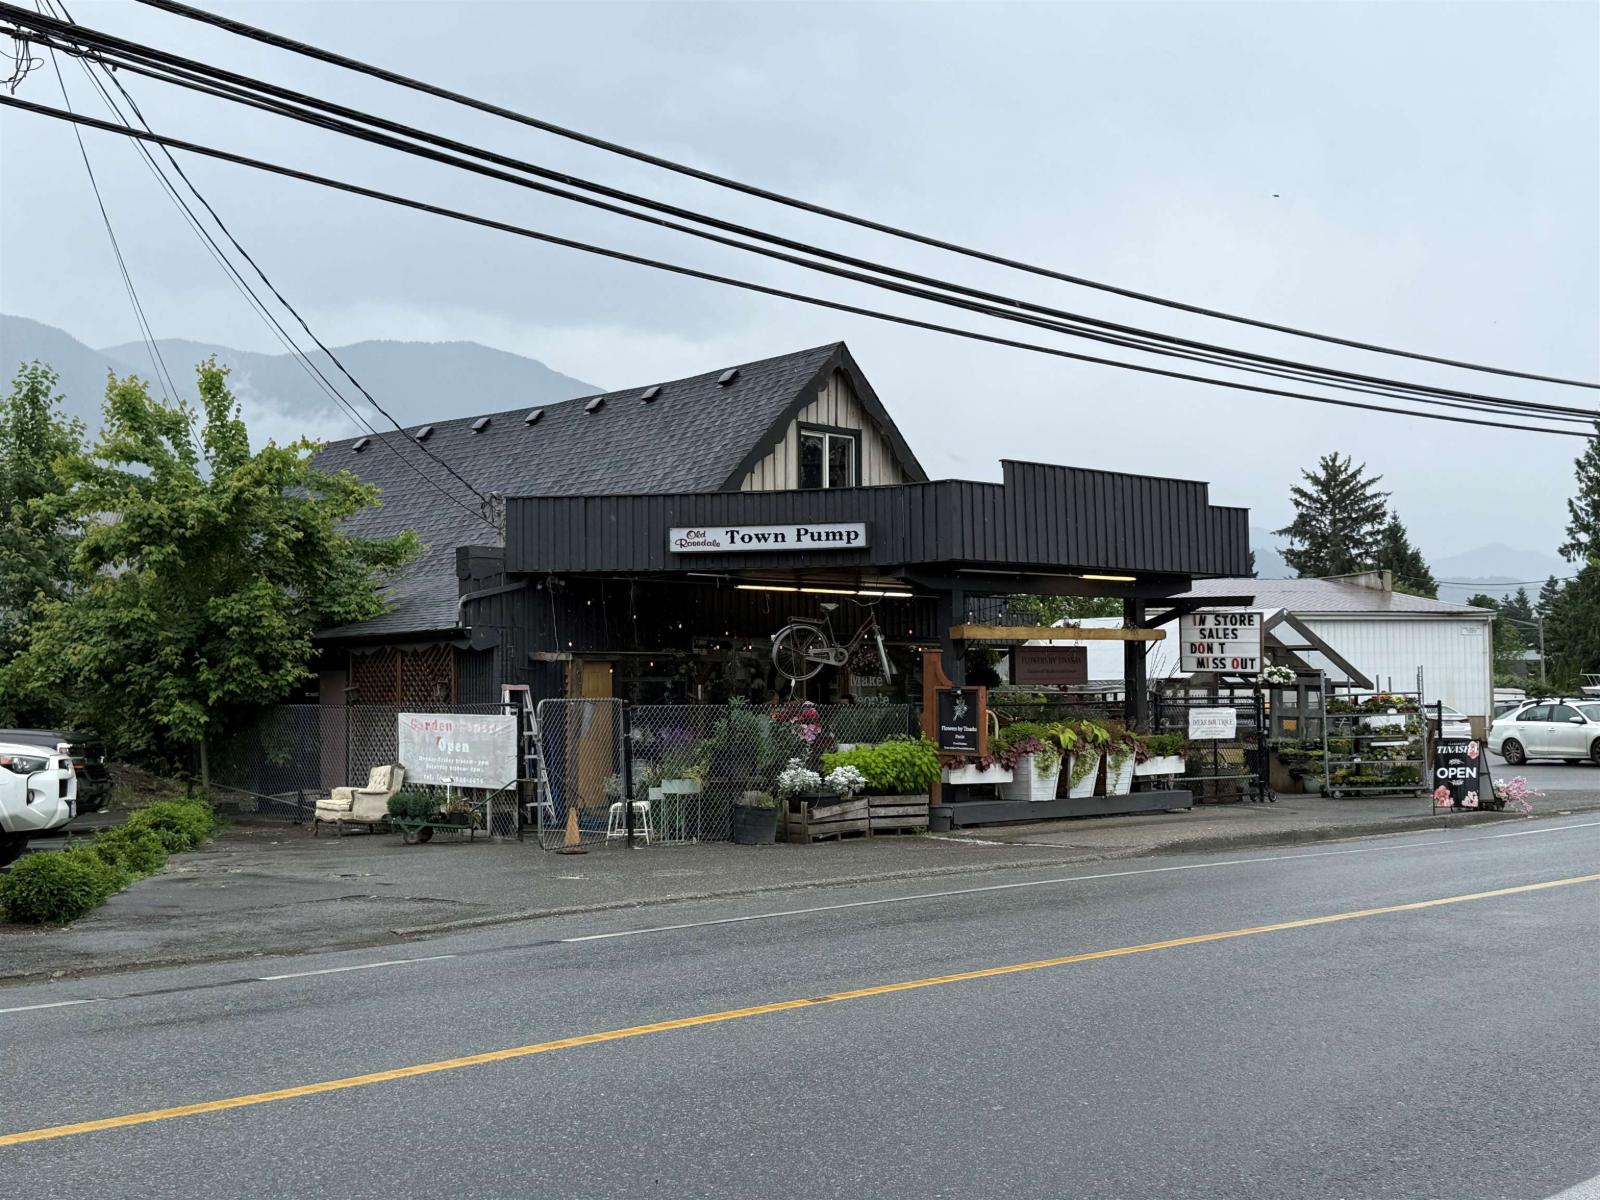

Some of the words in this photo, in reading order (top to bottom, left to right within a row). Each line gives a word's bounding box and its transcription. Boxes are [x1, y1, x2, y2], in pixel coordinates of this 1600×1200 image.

[686, 530, 706, 540] Old
[725, 529, 786, 544] Town
[795, 527, 859, 544] Pump
[675, 538, 721, 548] Rosedale
[1193, 615, 1206, 626] IN
[1214, 614, 1254, 626] STORE
[1199, 628, 1238, 639] SALES
[1196, 657, 1227, 669] MISS
[1231, 657, 1256, 670] OUT
[850, 674, 883, 687] Make
[438, 739, 470, 755] Open
[1436, 766, 1477, 779] OPEN
